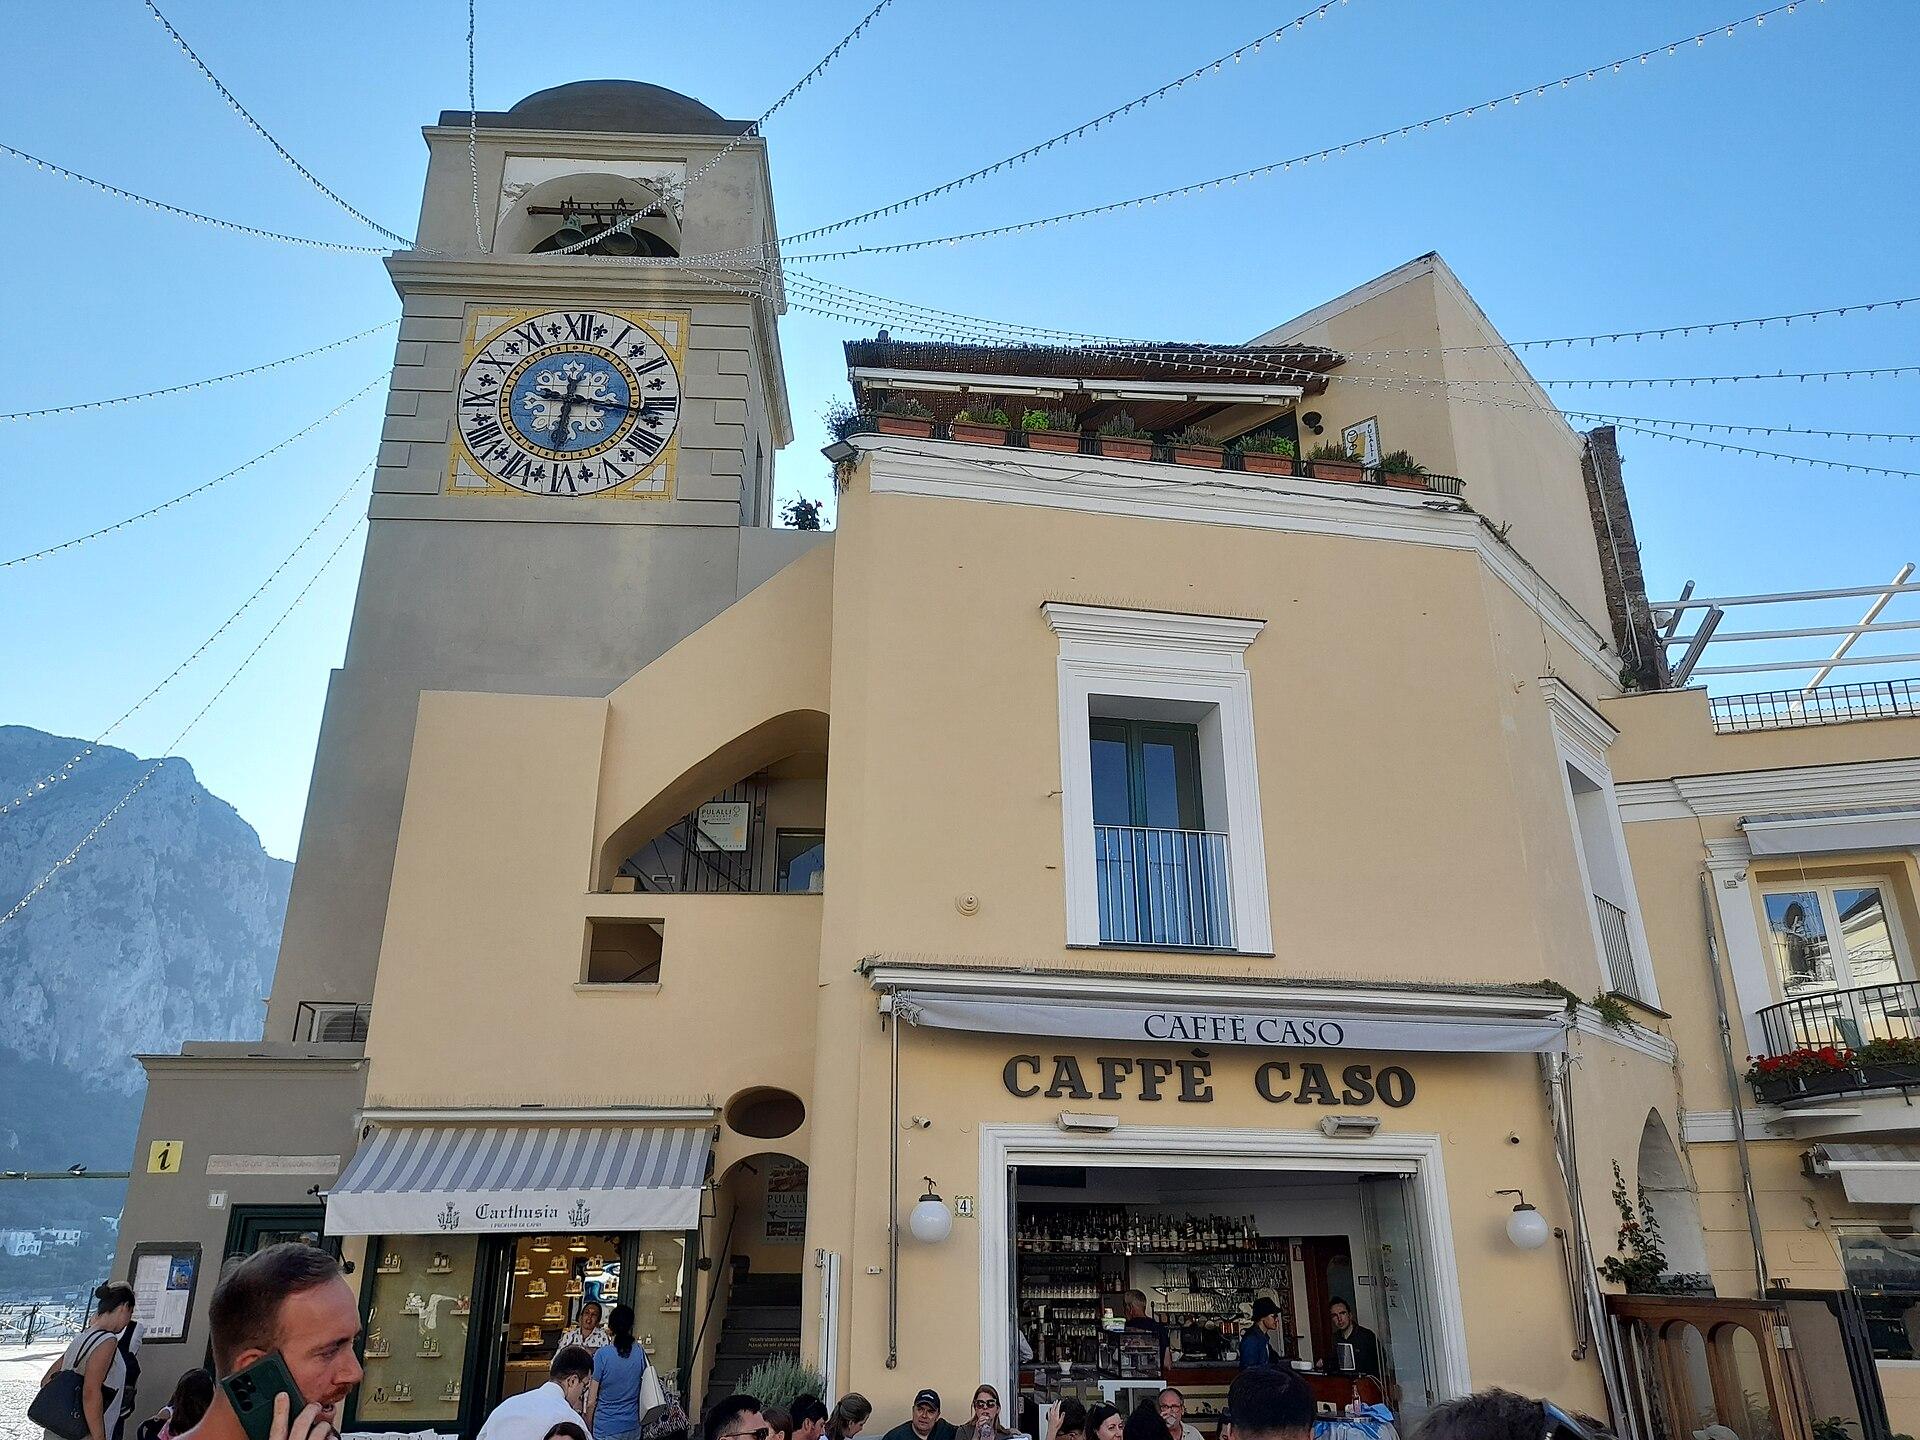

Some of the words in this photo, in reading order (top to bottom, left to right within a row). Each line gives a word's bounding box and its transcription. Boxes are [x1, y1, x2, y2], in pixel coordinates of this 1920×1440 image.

[513, 321, 547, 352] XI
[563, 313, 595, 341] XII
[609, 324, 633, 349] I
[477, 351, 515, 375] X
[635, 355, 668, 376] II
[462, 388, 498, 409] IX
[465, 422, 502, 461] VIII
[498, 450, 533, 486] VII
[550, 463, 577, 493] VI
[601, 457, 627, 485] V
[1144, 1013, 1248, 1043] CAFFÈ
[1256, 1018, 1345, 1047] CASO
[1002, 1047, 1214, 1103] CAFFÈ
[1254, 1060, 1417, 1108] CASO
[475, 1203, 558, 1220] Carthusia
[960, 1200, 967, 1212] 4
